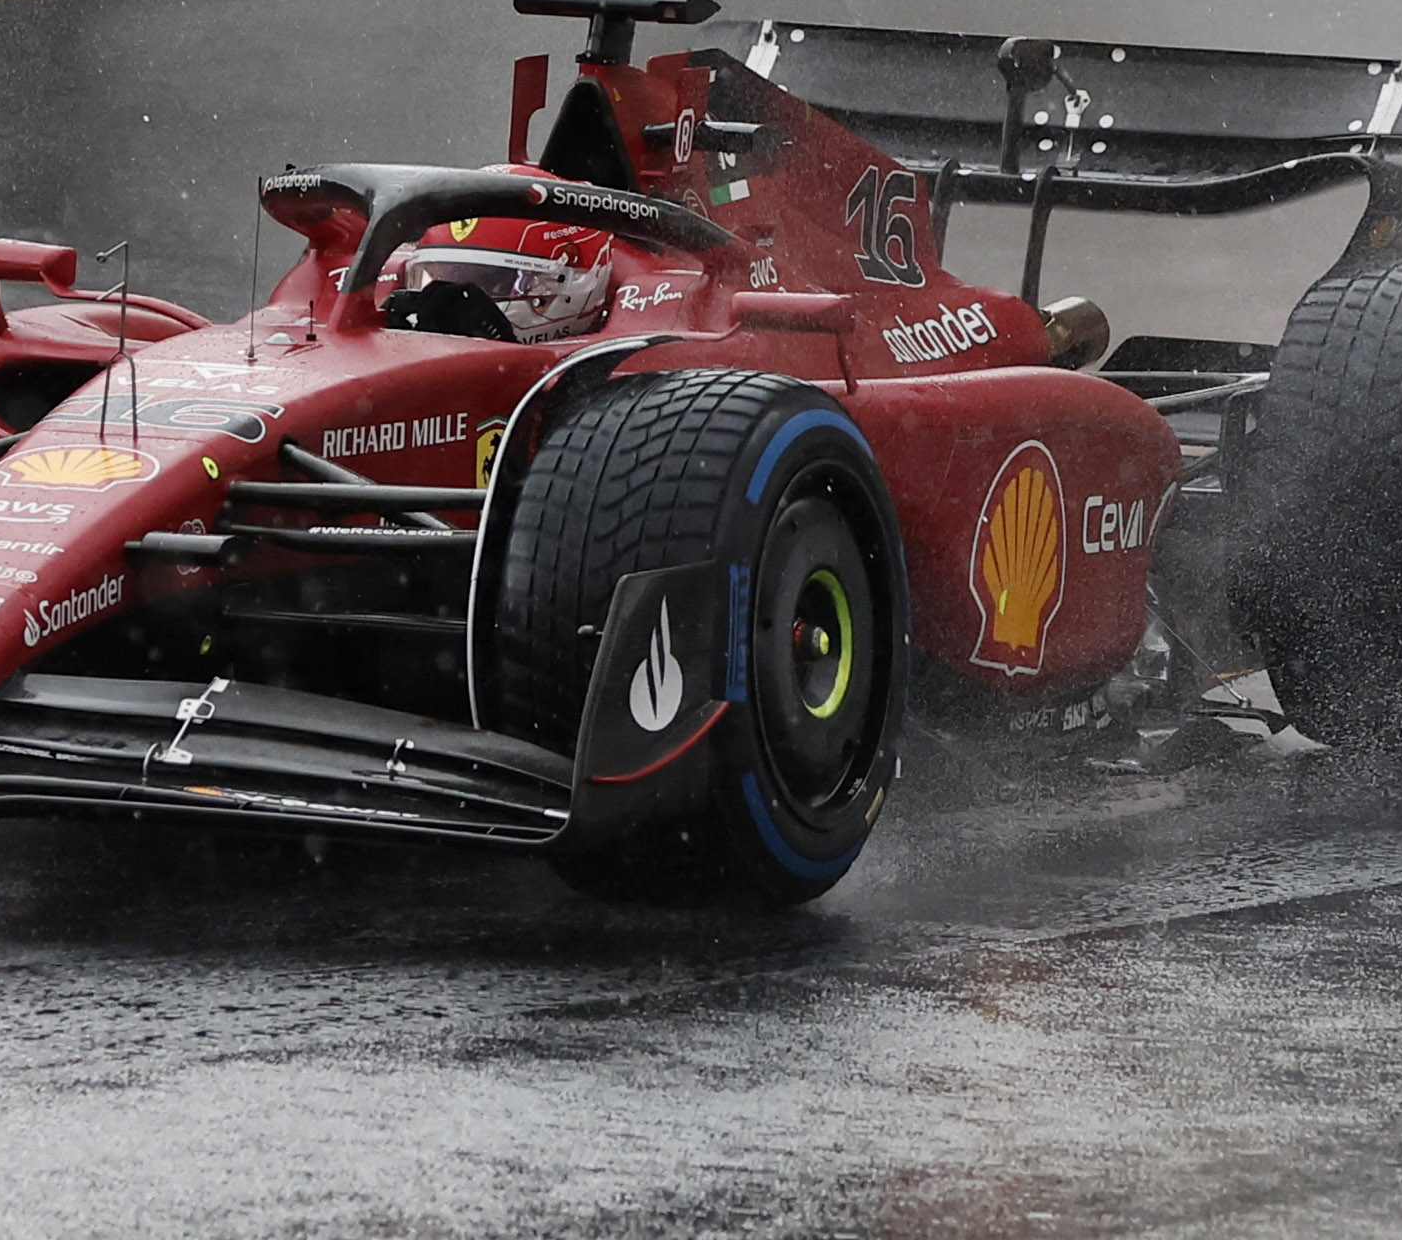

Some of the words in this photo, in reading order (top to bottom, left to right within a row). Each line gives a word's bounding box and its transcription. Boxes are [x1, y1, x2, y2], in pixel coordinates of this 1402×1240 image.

[553, 187, 659, 220] Snapdragon
[846, 165, 926, 288] 16
[750, 257, 778, 288] aws
[617, 282, 683, 311] Ray-Ban
[117, 376, 280, 396] VELAS
[39, 393, 286, 443] 16
[322, 422, 405, 458] RICHARD
[411, 413, 468, 448] MILLE
[308, 526, 453, 537] #WeRaceAsOne
[39, 573, 125, 637] Santander
